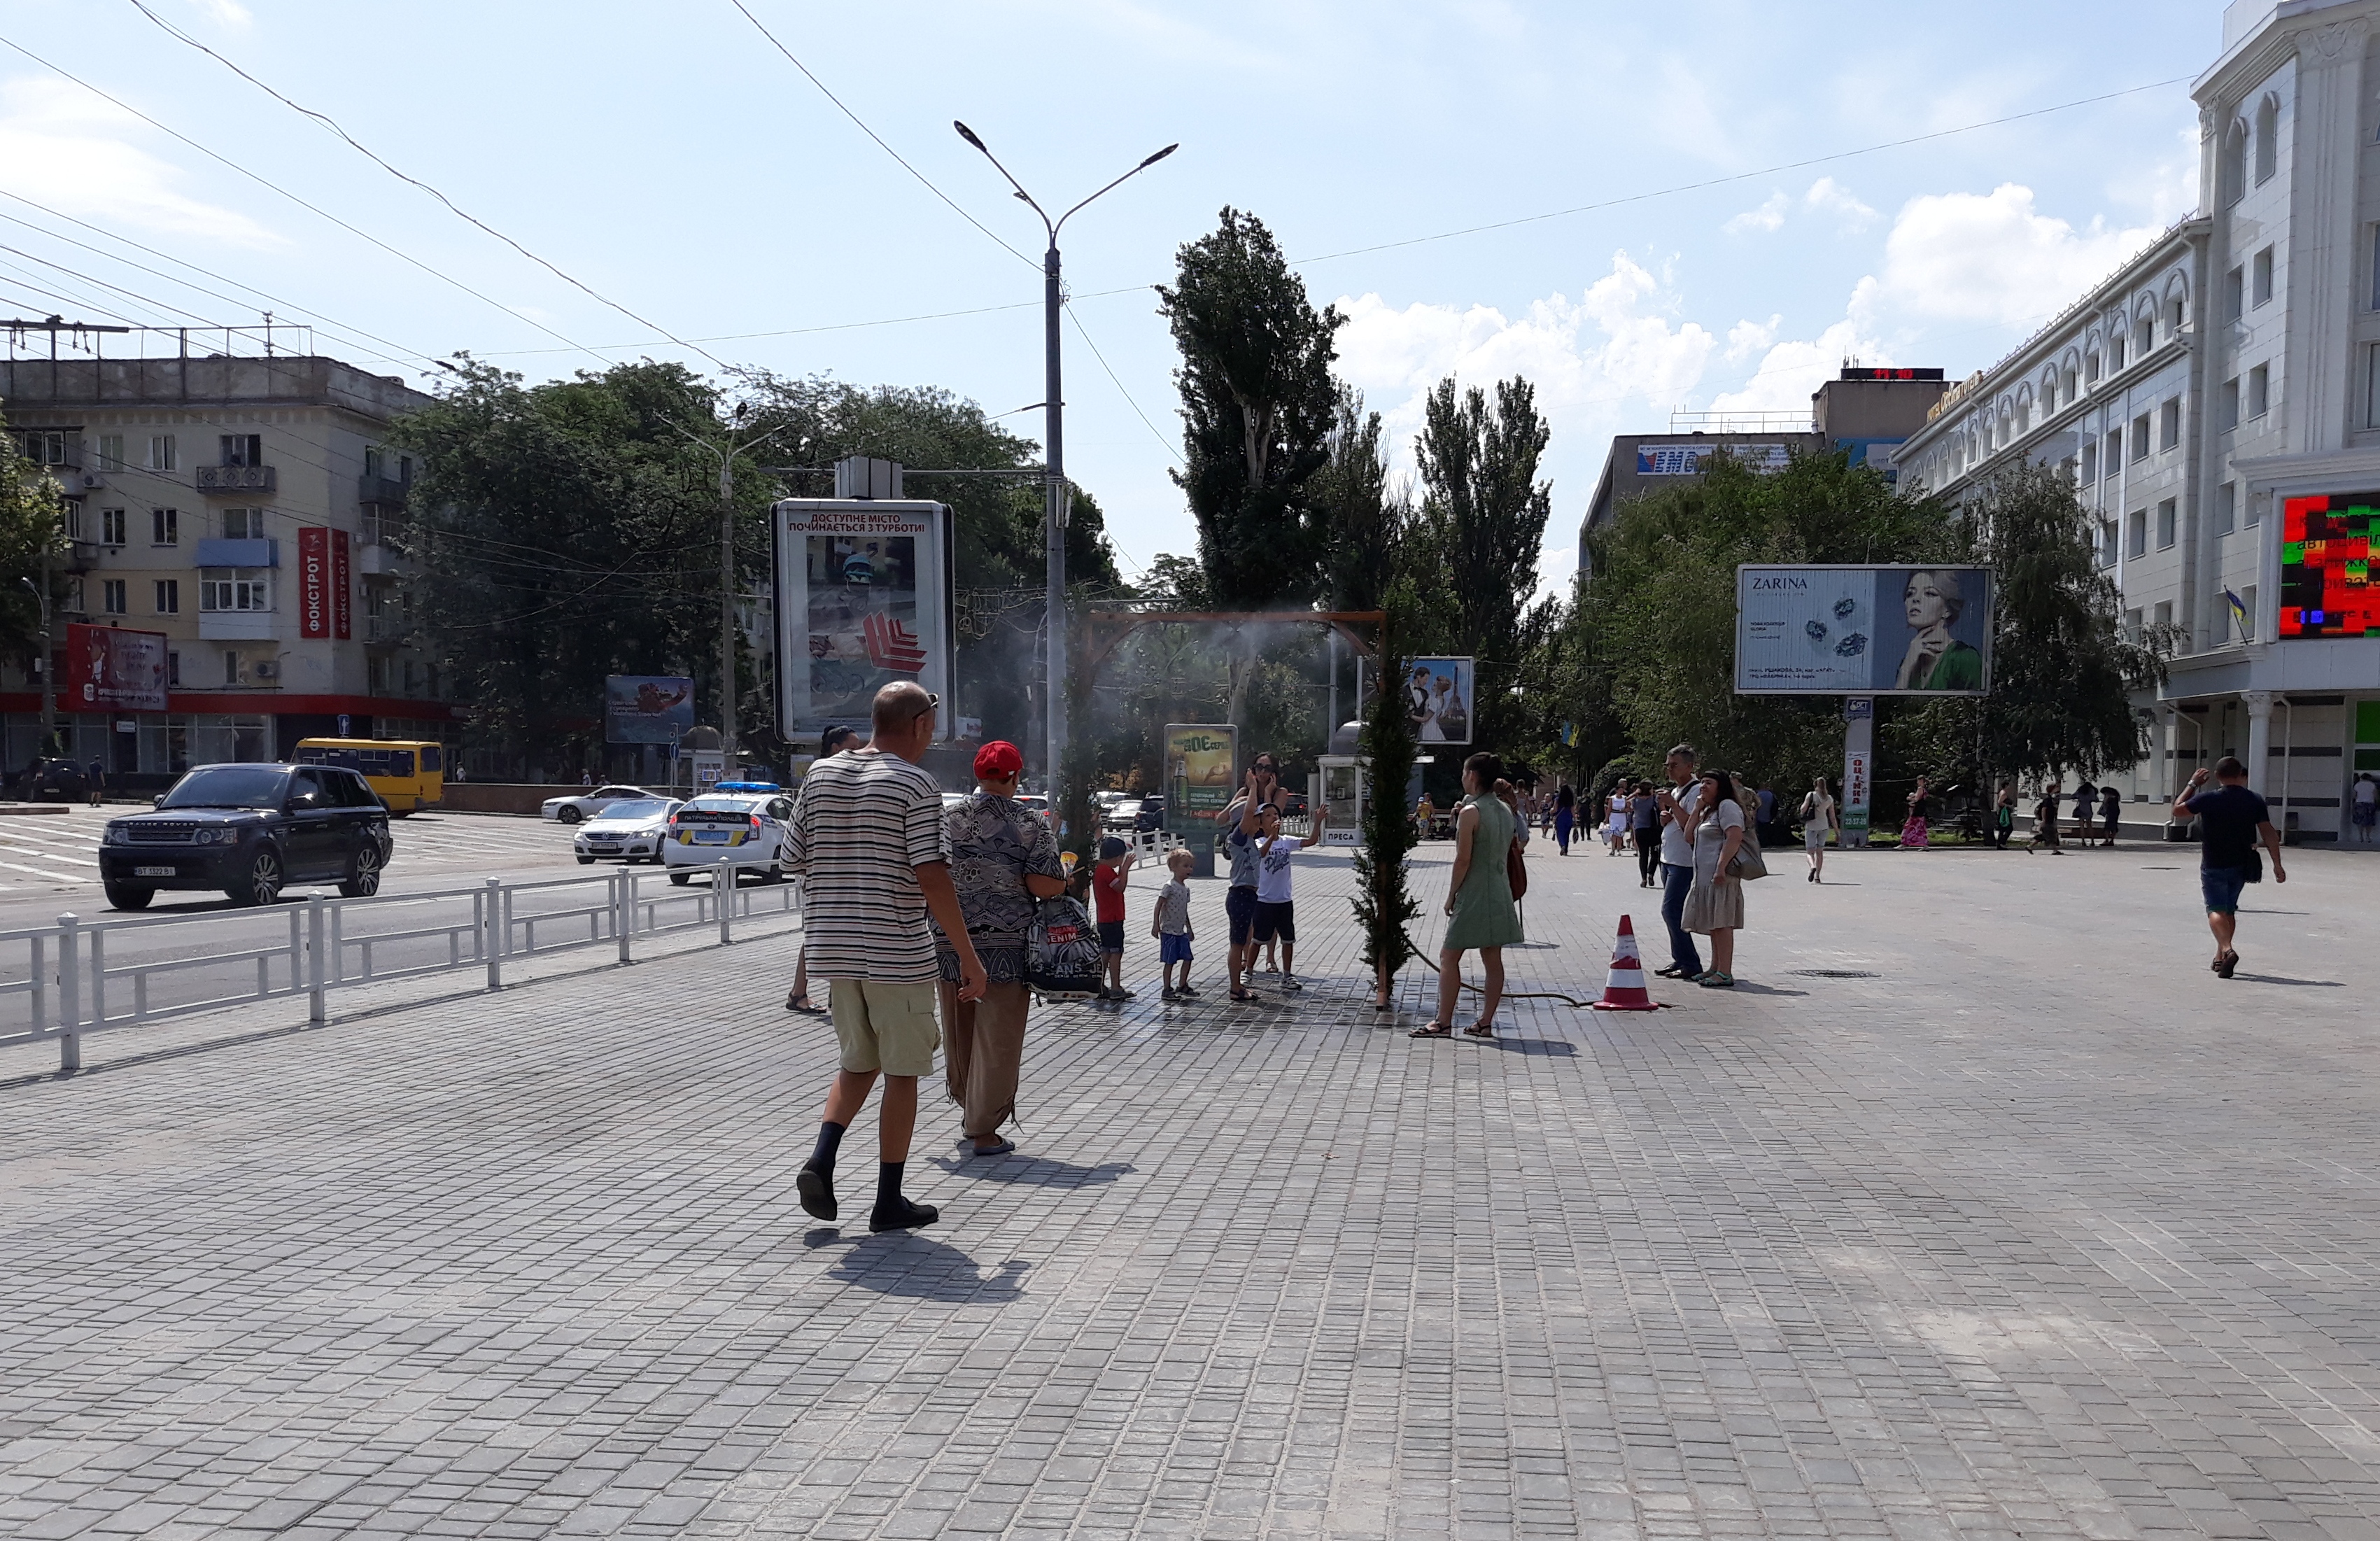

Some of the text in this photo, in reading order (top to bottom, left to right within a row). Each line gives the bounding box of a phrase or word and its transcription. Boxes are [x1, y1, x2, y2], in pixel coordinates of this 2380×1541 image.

[811, 514, 901, 523] ДОСТУПНЕ МІСТО
[789, 522, 866, 532] ПОЧИНАЄТЬСЯ
[875, 523, 924, 533] ТУРБОТИ!
[1752, 577, 1807, 589] ZARINA
[307, 556, 321, 631] ФОКСТРОТ
